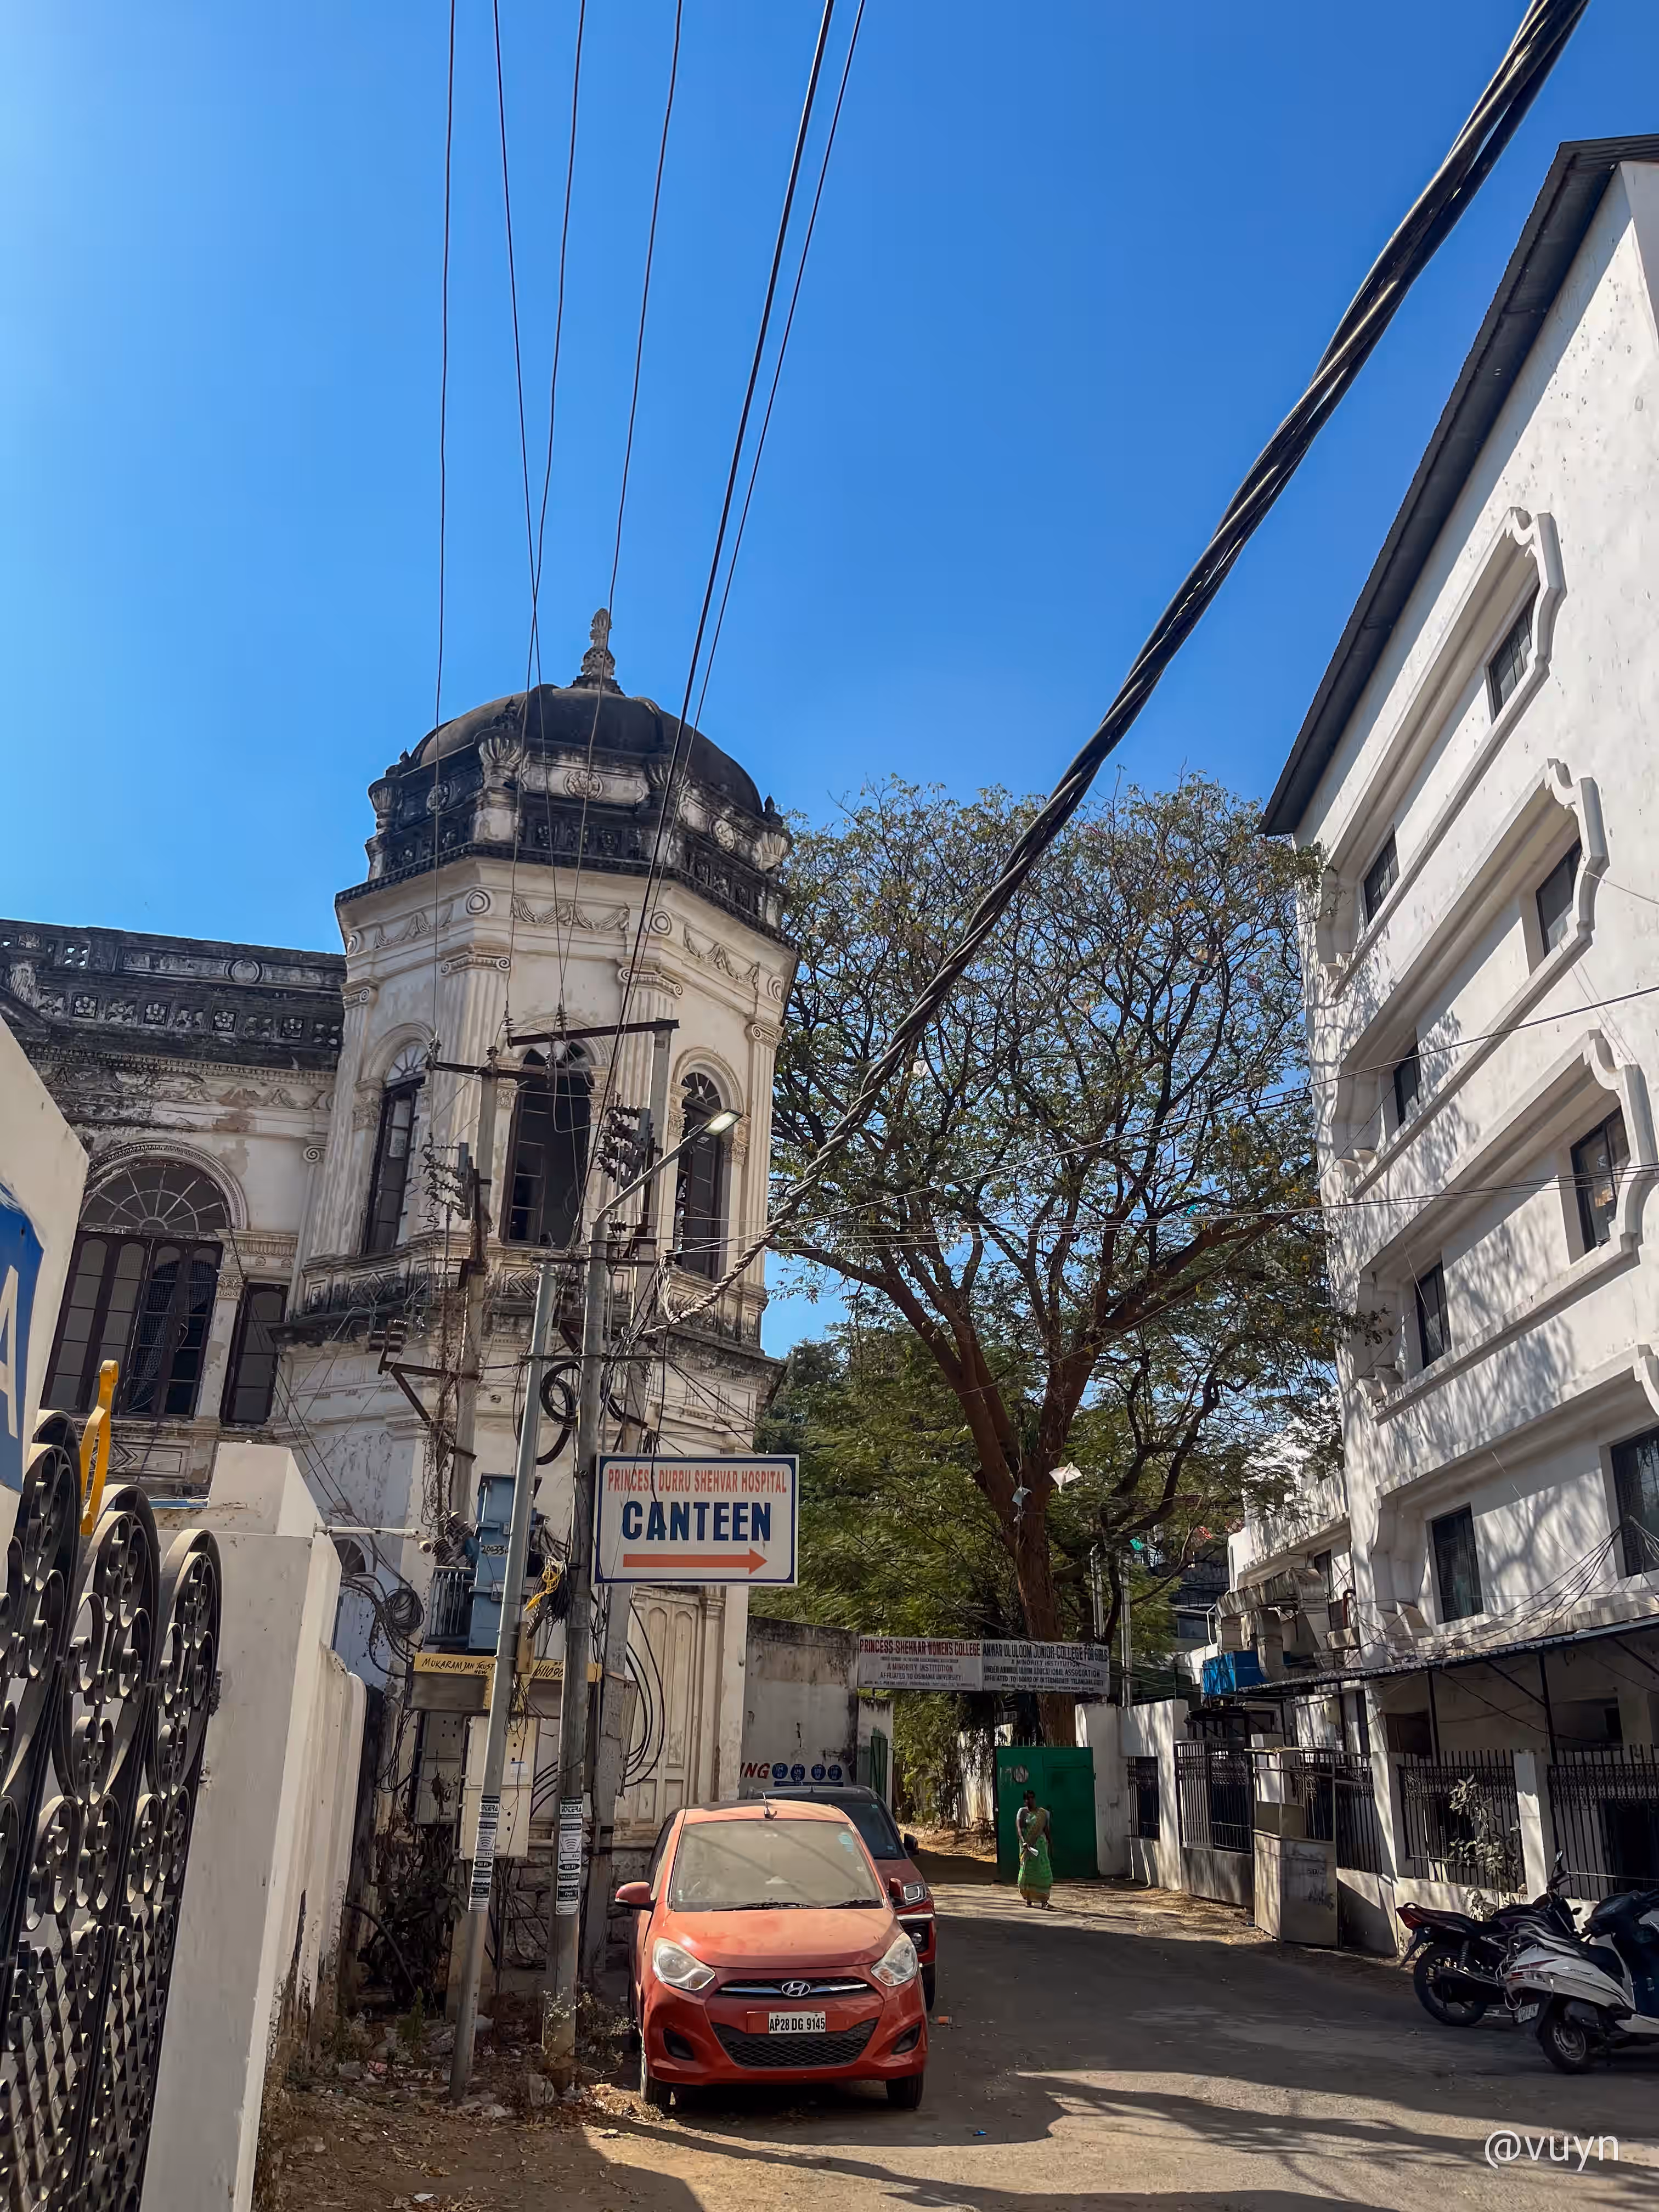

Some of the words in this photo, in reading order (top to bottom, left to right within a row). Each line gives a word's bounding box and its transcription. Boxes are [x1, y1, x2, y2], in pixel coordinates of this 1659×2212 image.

[659, 1470, 691, 1492] DURRU
[695, 1470, 738, 1492] SHEHVAR
[742, 1471, 787, 1493] HOSPITAL
[622, 1501, 771, 1541] CANTEEN
[860, 1639, 893, 1654] PRINCESS
[955, 1641, 980, 1656] COLLEGE
[1034, 1645, 1054, 1659] JUNIOR
[1057, 1646, 1082, 1660] COLLEGE
[892, 1663, 917, 1671] MINORITY
[920, 1663, 953, 1672] INSTITUTION
[1065, 1669, 1100, 1677] ASSOCIATION
[770, 2018, 789, 2030] AP28
[792, 2018, 804, 2030] DG
[806, 2017, 825, 2030] 9145
